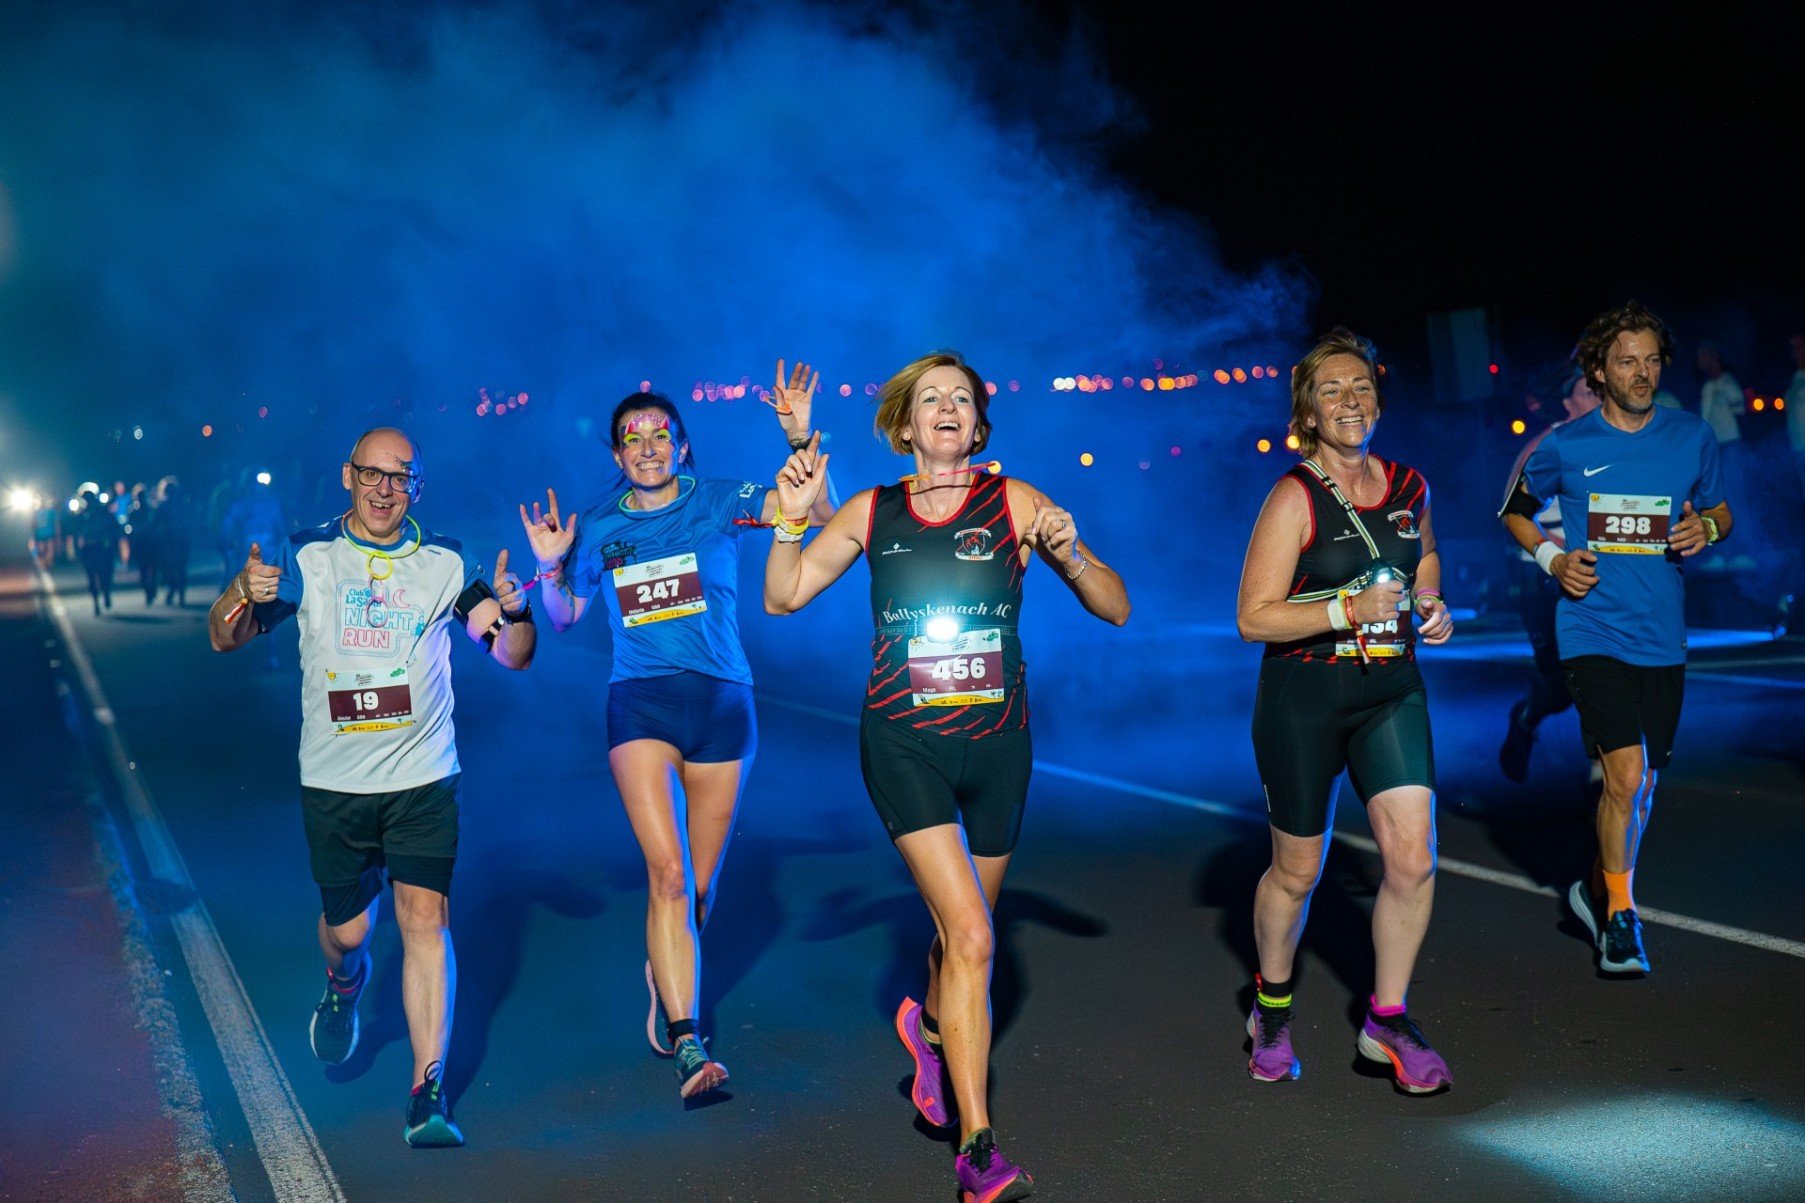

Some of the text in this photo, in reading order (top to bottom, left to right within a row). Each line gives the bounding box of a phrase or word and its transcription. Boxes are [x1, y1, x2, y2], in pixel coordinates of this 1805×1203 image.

[1606, 516, 1650, 535] 298
[345, 594, 356, 604] La
[349, 588, 364, 596] Club
[637, 579, 680, 604] 247
[883, 602, 1012, 624] Ballyskenach AC
[342, 628, 390, 648] RUN
[932, 657, 985, 680] 456
[352, 691, 379, 711] 19
